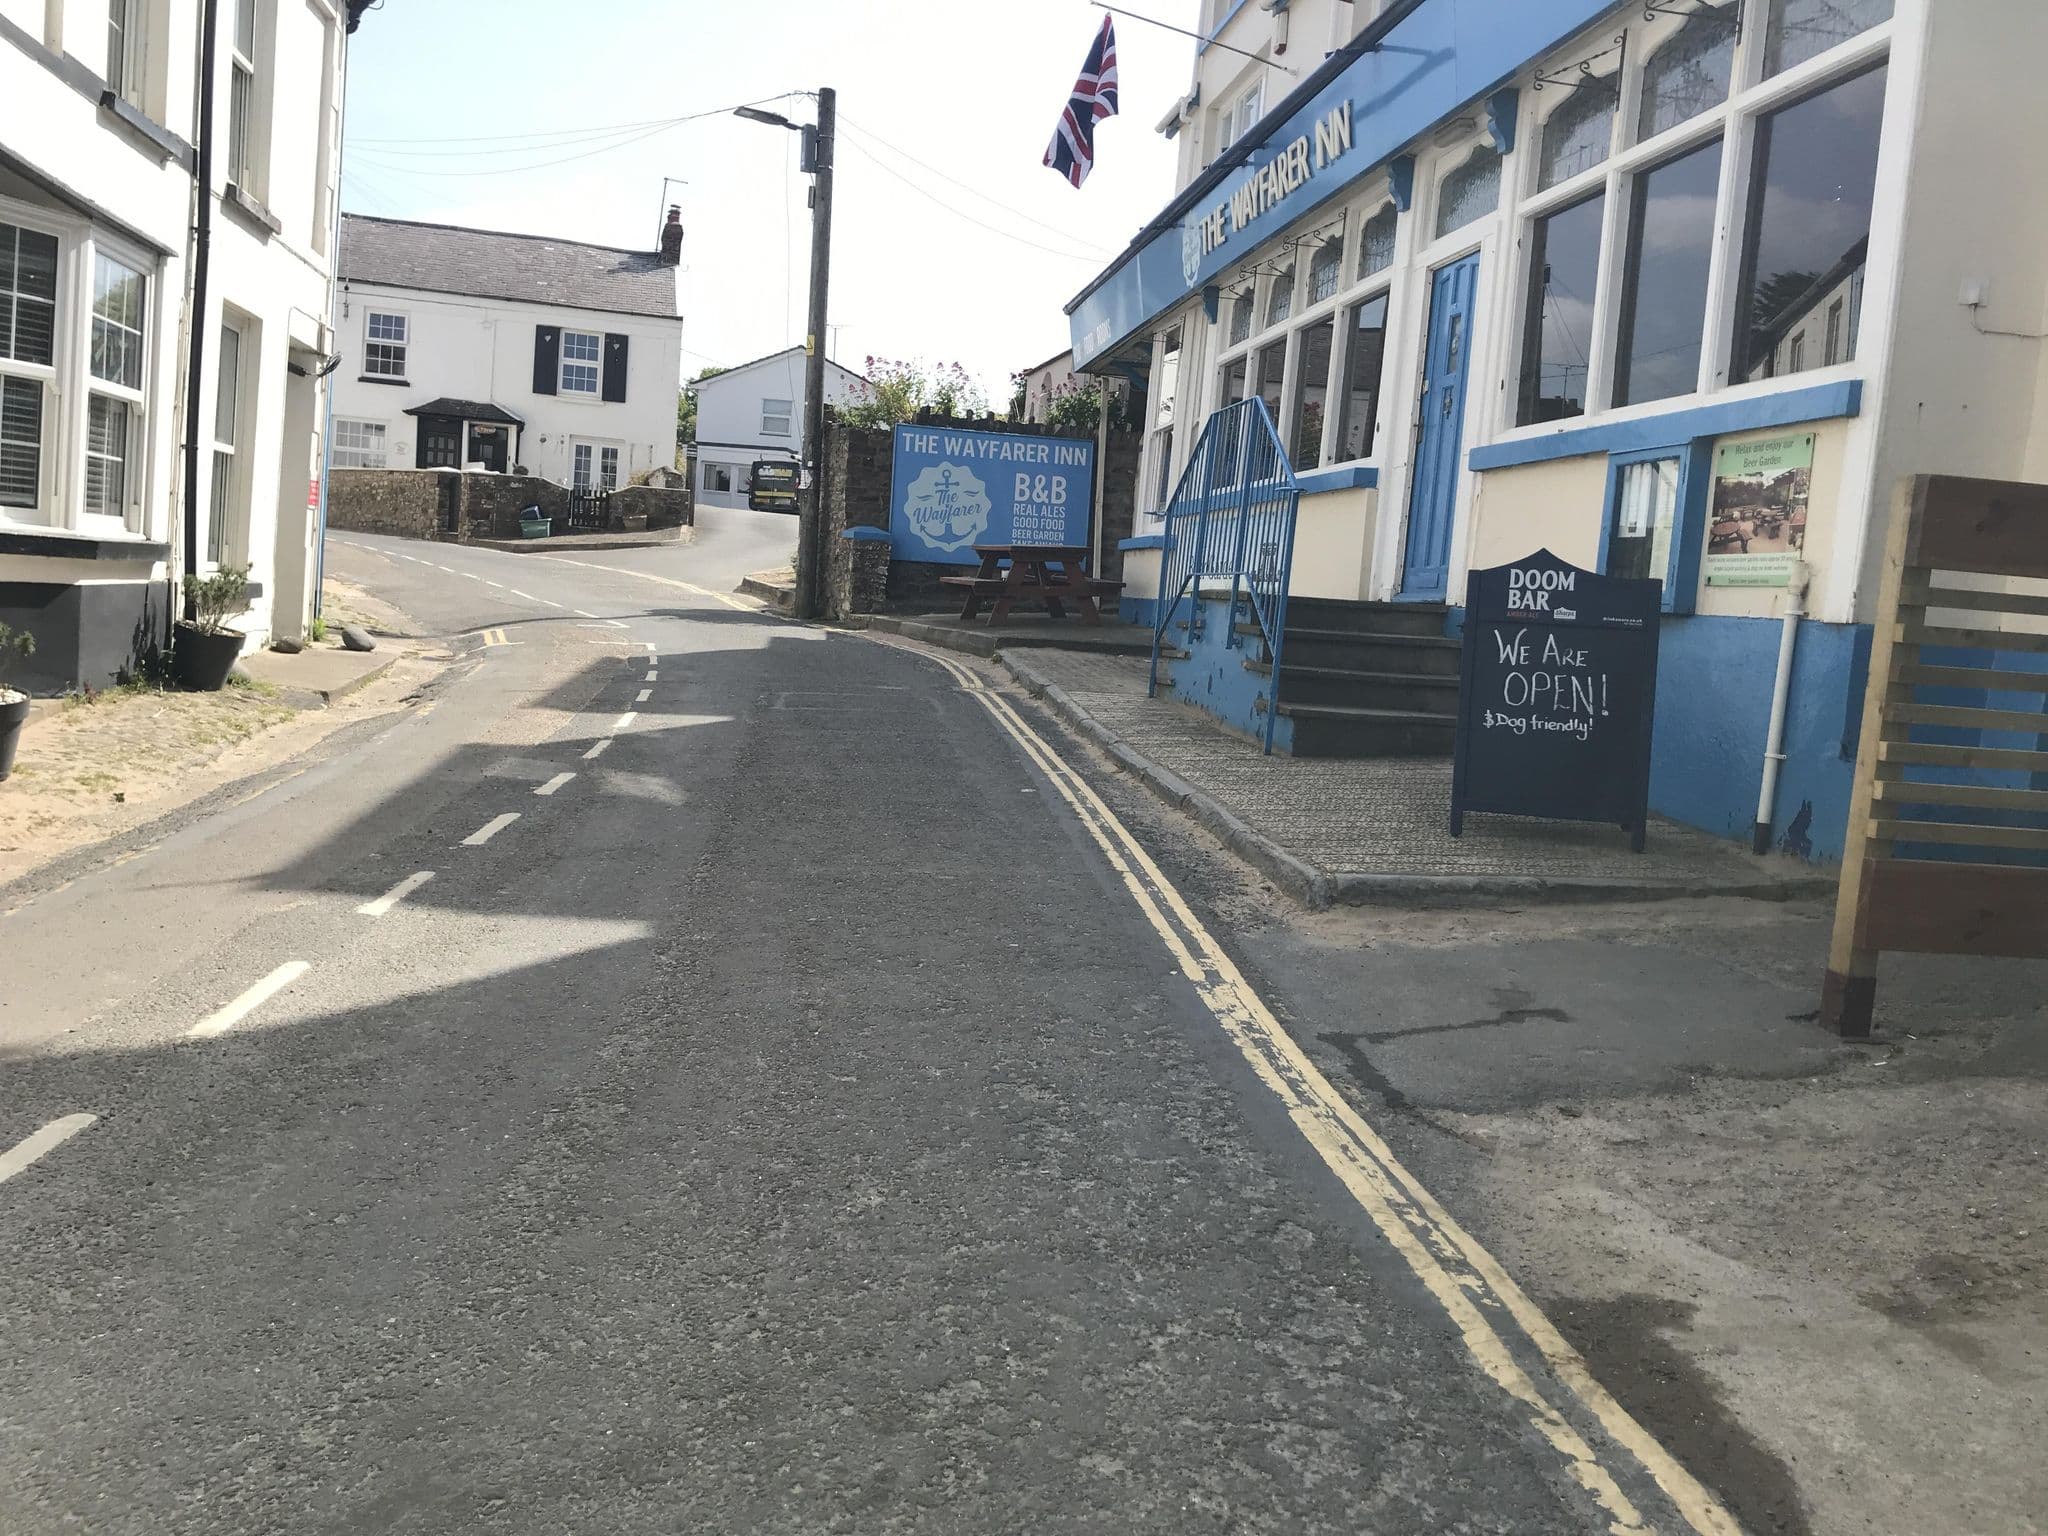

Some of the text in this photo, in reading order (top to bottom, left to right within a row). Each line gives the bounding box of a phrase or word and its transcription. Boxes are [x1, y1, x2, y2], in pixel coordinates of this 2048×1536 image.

[1200, 203, 1226, 256] THE
[1230, 135, 1312, 233] WAYFARER
[902, 432, 1087, 466] THE WAYFARER INN
[1743, 454, 1782, 468] Beer Garden
[935, 489, 959, 506] The
[1014, 472, 1067, 505] B&B
[913, 502, 982, 525] Wayfarer
[1013, 503, 1066, 518] REAL ALES
[1013, 516, 1065, 531] GOOD FOOD
[1011, 528, 1065, 542] BEER GARDEN
[1508, 568, 1576, 592] DOOM
[1507, 589, 1550, 611] BAR
[1530, 714, 1593, 741] friendly!
